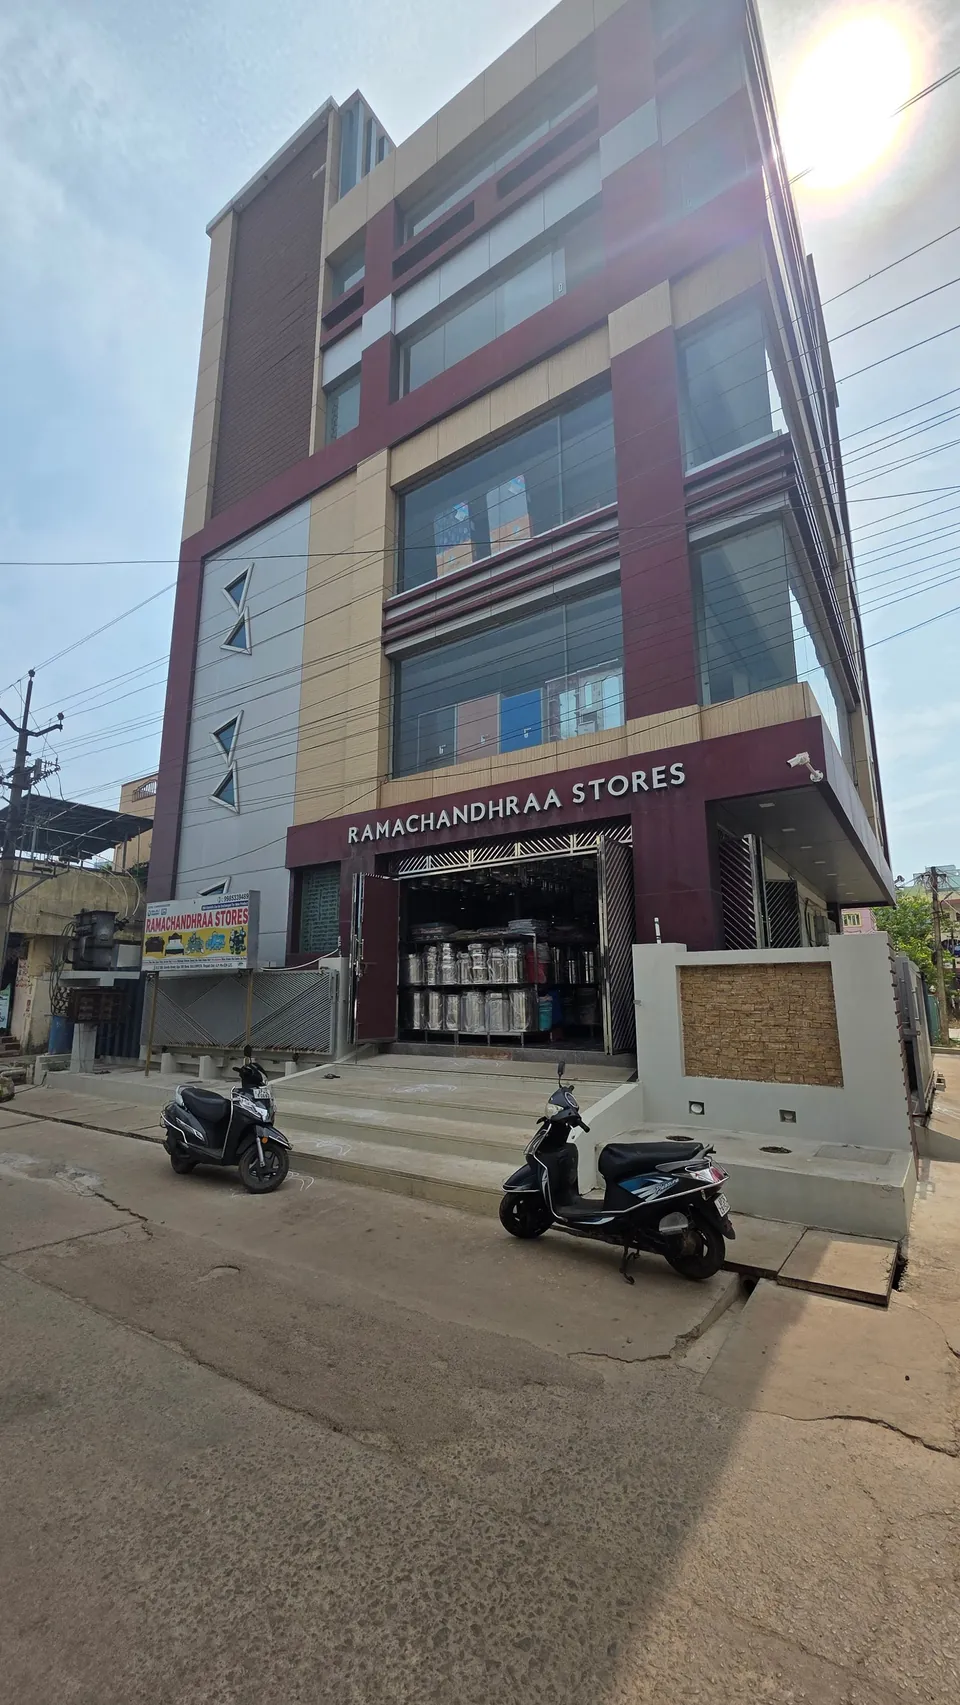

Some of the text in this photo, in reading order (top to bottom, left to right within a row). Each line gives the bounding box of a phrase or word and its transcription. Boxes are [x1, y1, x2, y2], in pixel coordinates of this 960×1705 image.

[348, 762, 686, 844] RAMACHANDHRAA STORES
[146, 908, 249, 933] RAMACHANDHRAA STORES
